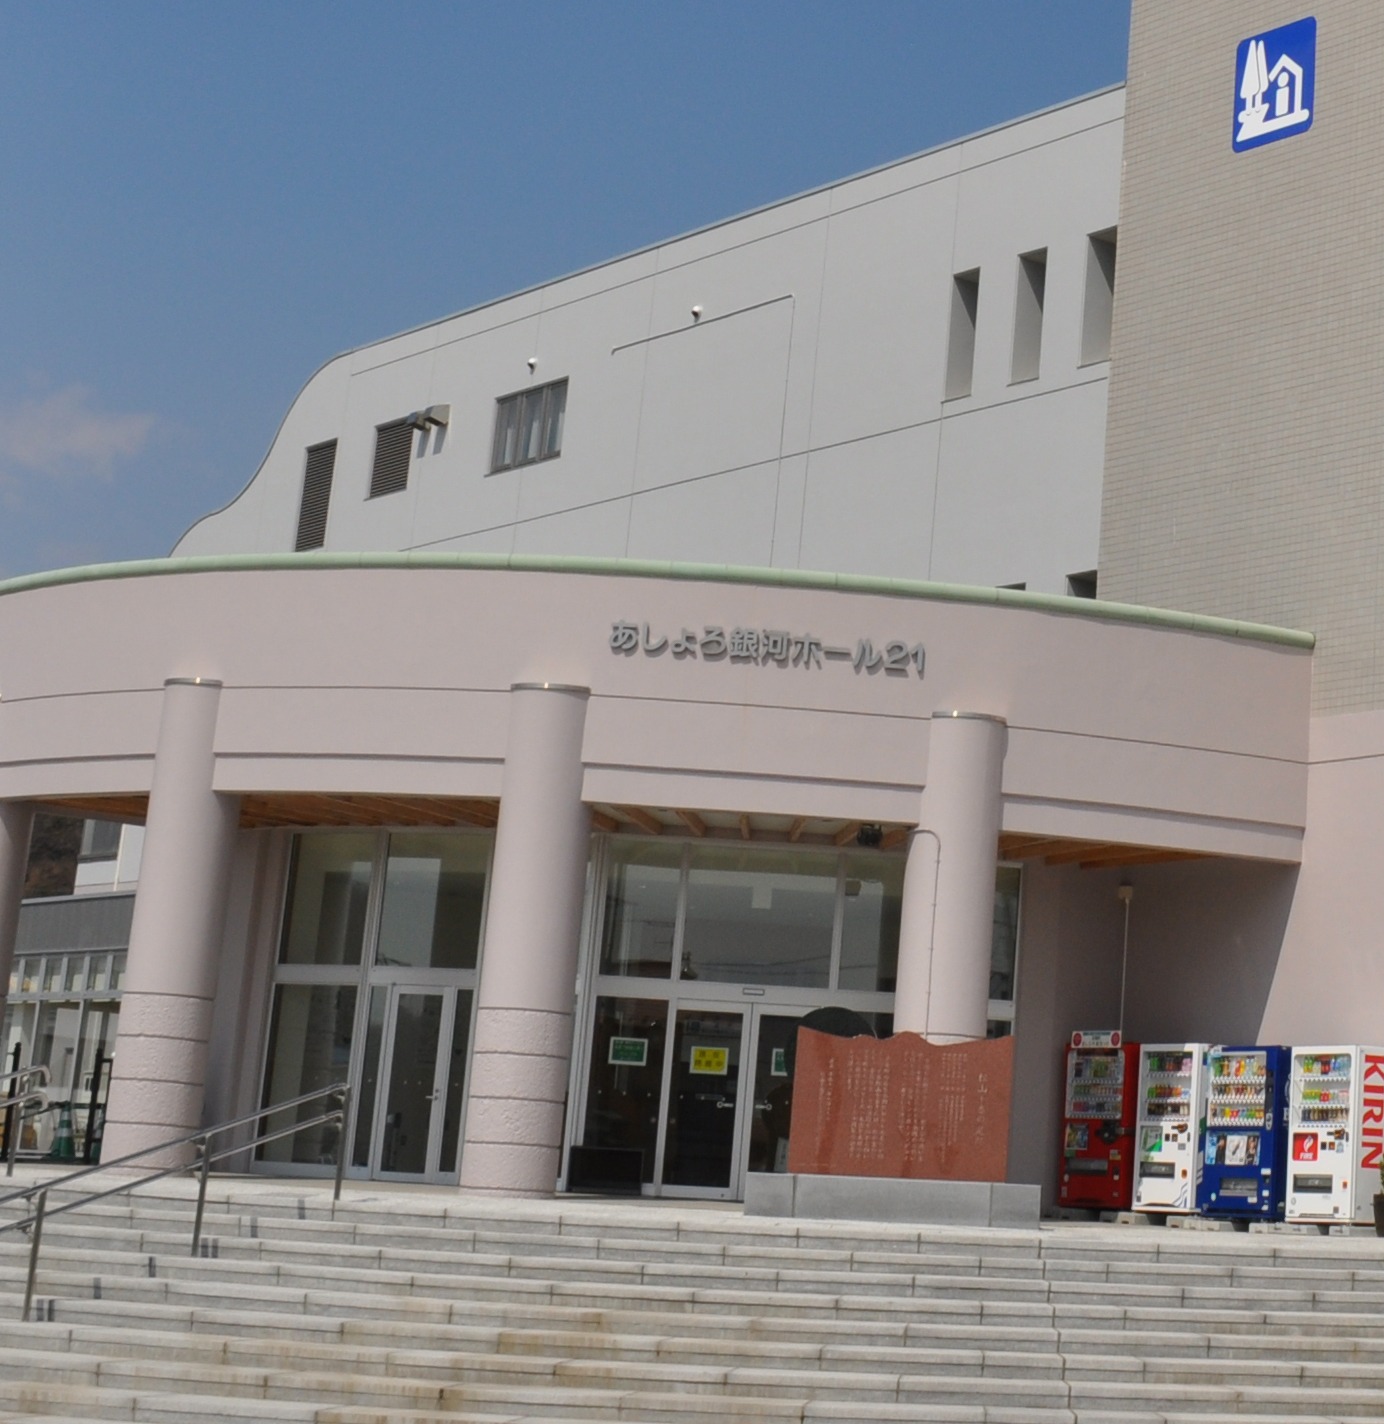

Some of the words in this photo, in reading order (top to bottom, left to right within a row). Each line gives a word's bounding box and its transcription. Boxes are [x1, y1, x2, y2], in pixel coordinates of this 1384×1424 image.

[608, 620, 926, 676] あしょろ銀河ホール21
